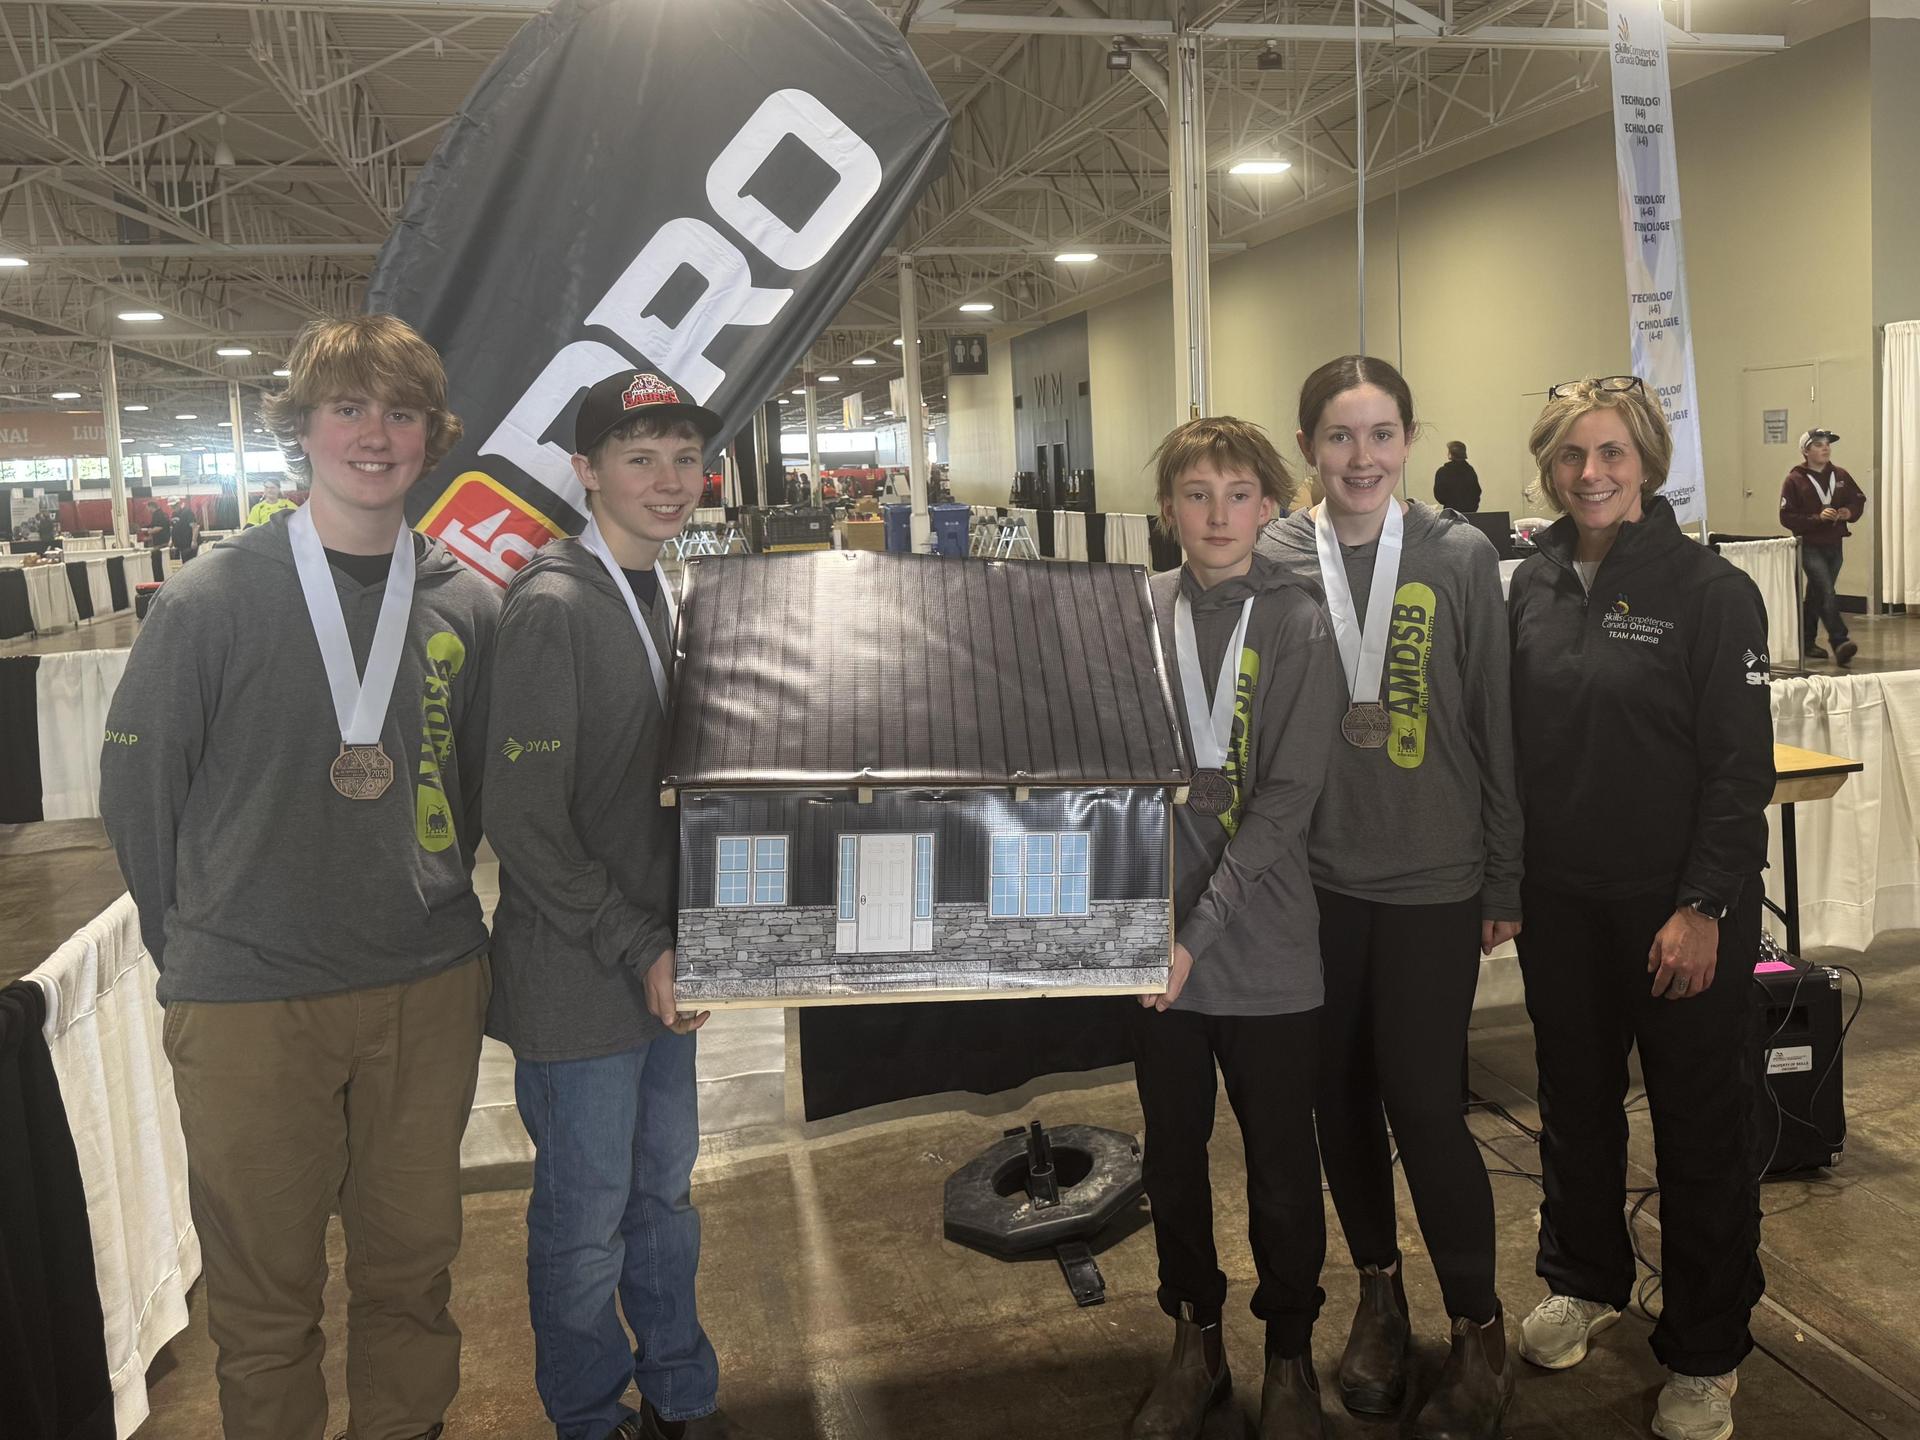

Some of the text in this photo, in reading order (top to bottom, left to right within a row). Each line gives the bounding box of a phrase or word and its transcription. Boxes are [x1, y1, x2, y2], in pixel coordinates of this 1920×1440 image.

[1629, 622, 1663, 635] Ontario
[1608, 630, 1659, 645] TEAM AMDSB
[1389, 603, 1426, 720] AMDSB
